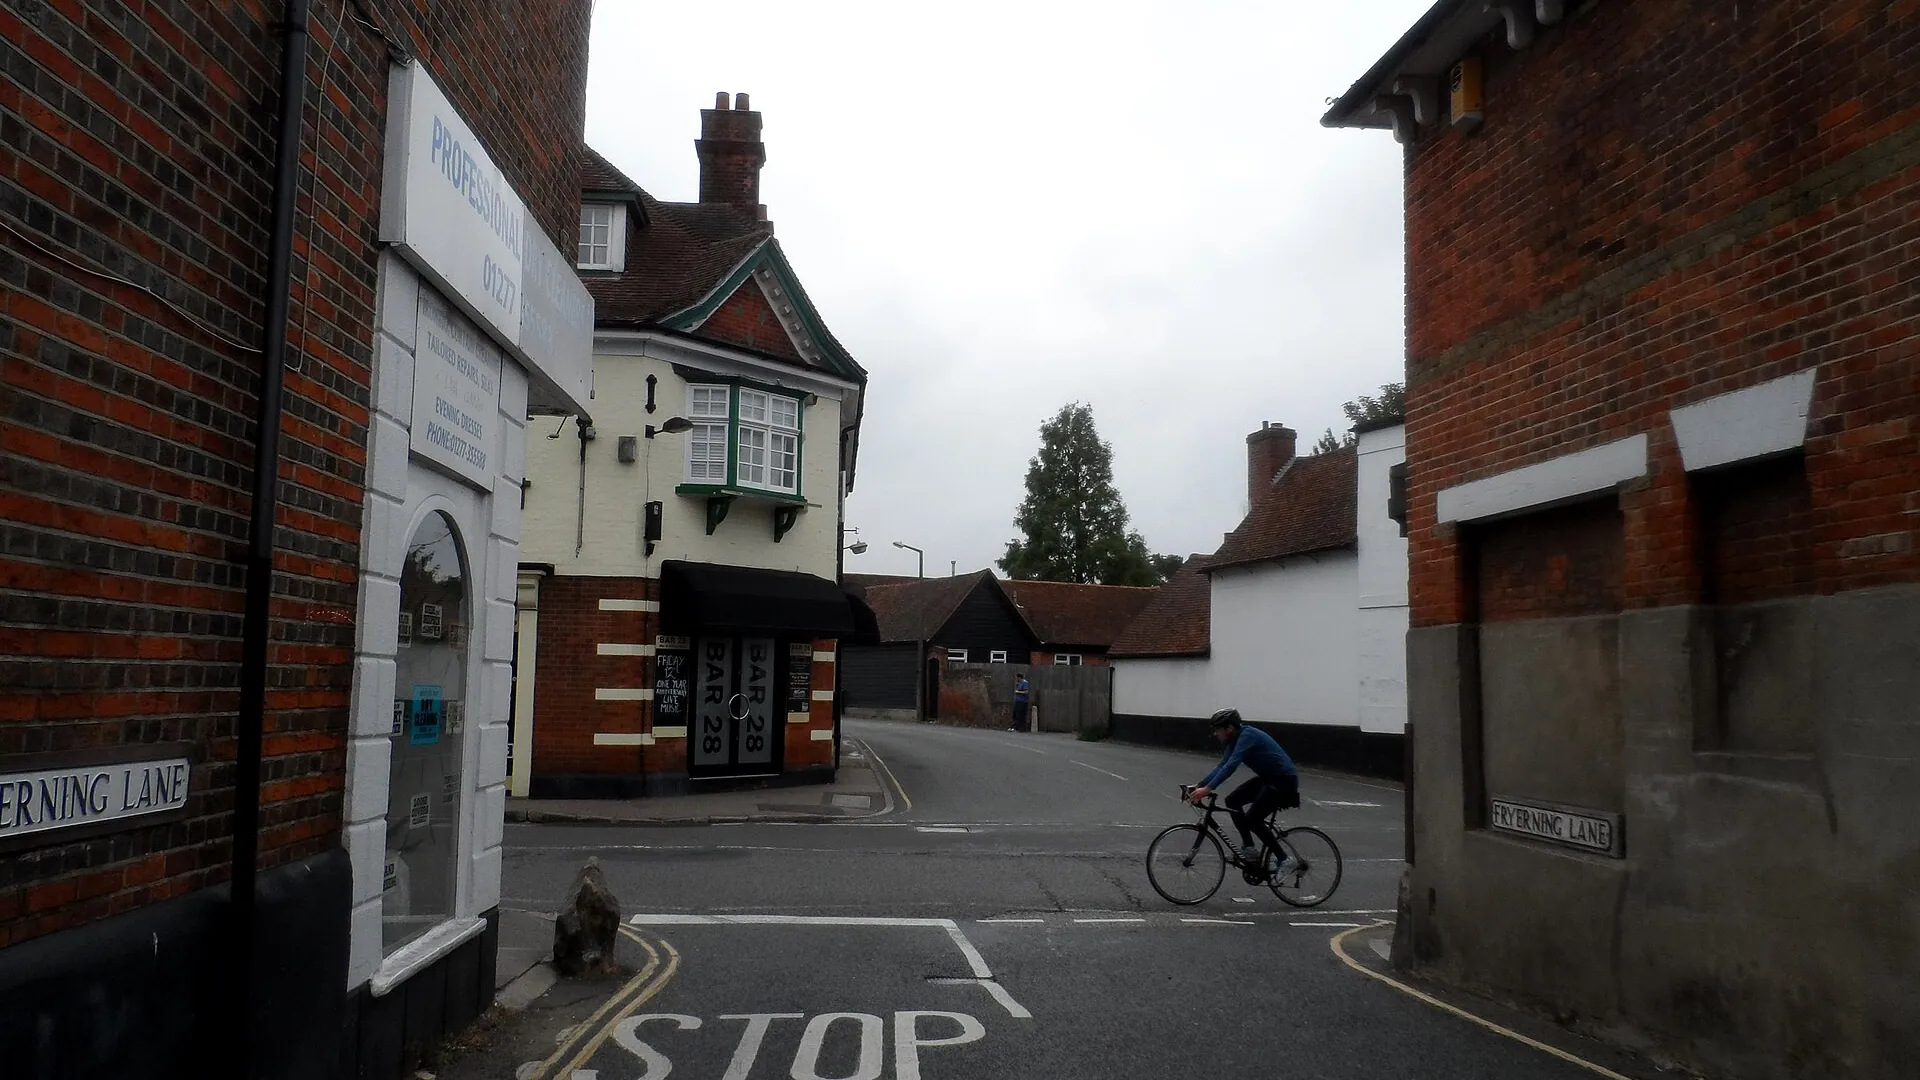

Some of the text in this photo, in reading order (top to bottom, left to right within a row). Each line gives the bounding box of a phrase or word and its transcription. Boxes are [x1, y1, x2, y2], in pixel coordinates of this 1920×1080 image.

[431, 115, 521, 261] PROFESSIONAL
[482, 254, 515, 316] 01277
[427, 331, 456, 368] TAILORED
[435, 396, 483, 441] EVENING DRESSES
[657, 654, 686, 667] FRIDAY
[659, 636, 676, 644] BAR
[656, 679, 669, 689] ONE
[663, 695, 678, 704] LIVE
[703, 641, 725, 754] BAR 28
[746, 643, 767, 753] BAR 28
[660, 703, 682, 713] MUSIC
[121, 764, 185, 812] LANE
[1492, 803, 1607, 845] FRYERNING LANE
[570, 1011, 986, 1080] STOP
